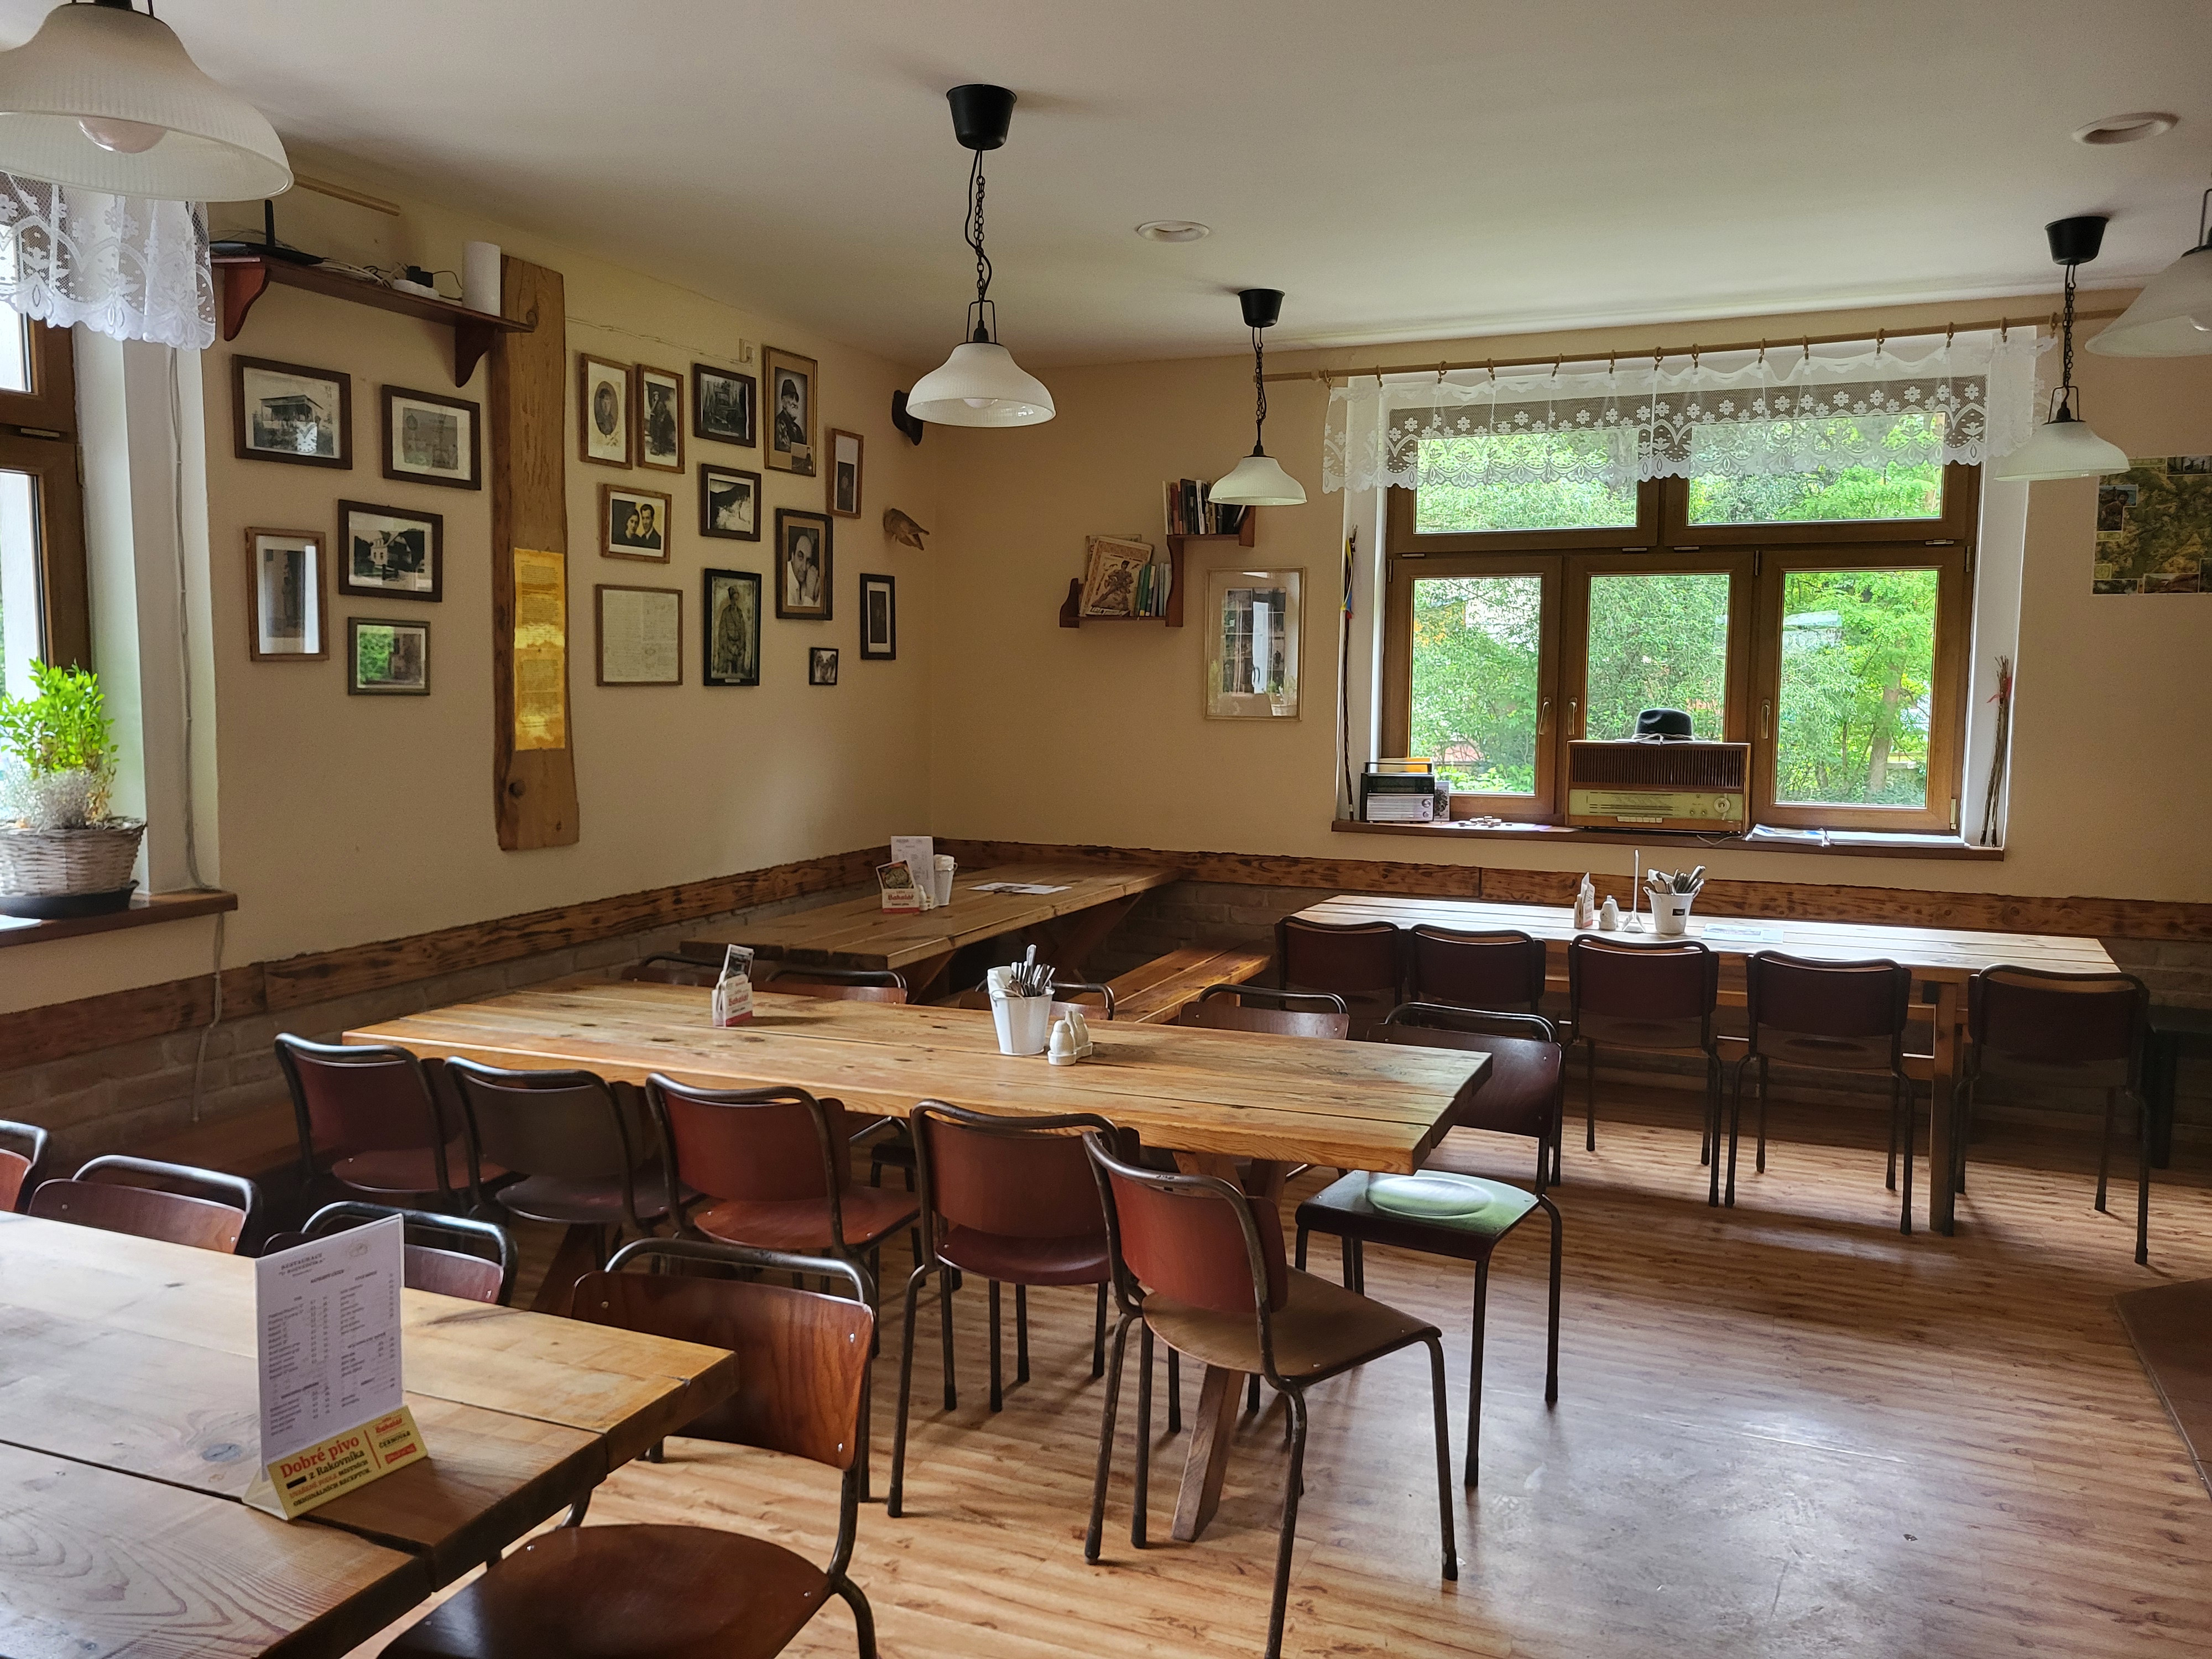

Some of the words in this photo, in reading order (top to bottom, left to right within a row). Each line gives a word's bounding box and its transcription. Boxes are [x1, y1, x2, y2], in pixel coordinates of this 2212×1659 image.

[280, 1447, 326, 1478] Dobré
[328, 1437, 360, 1461] pivo
[316, 1450, 365, 1475] Rakovníka
